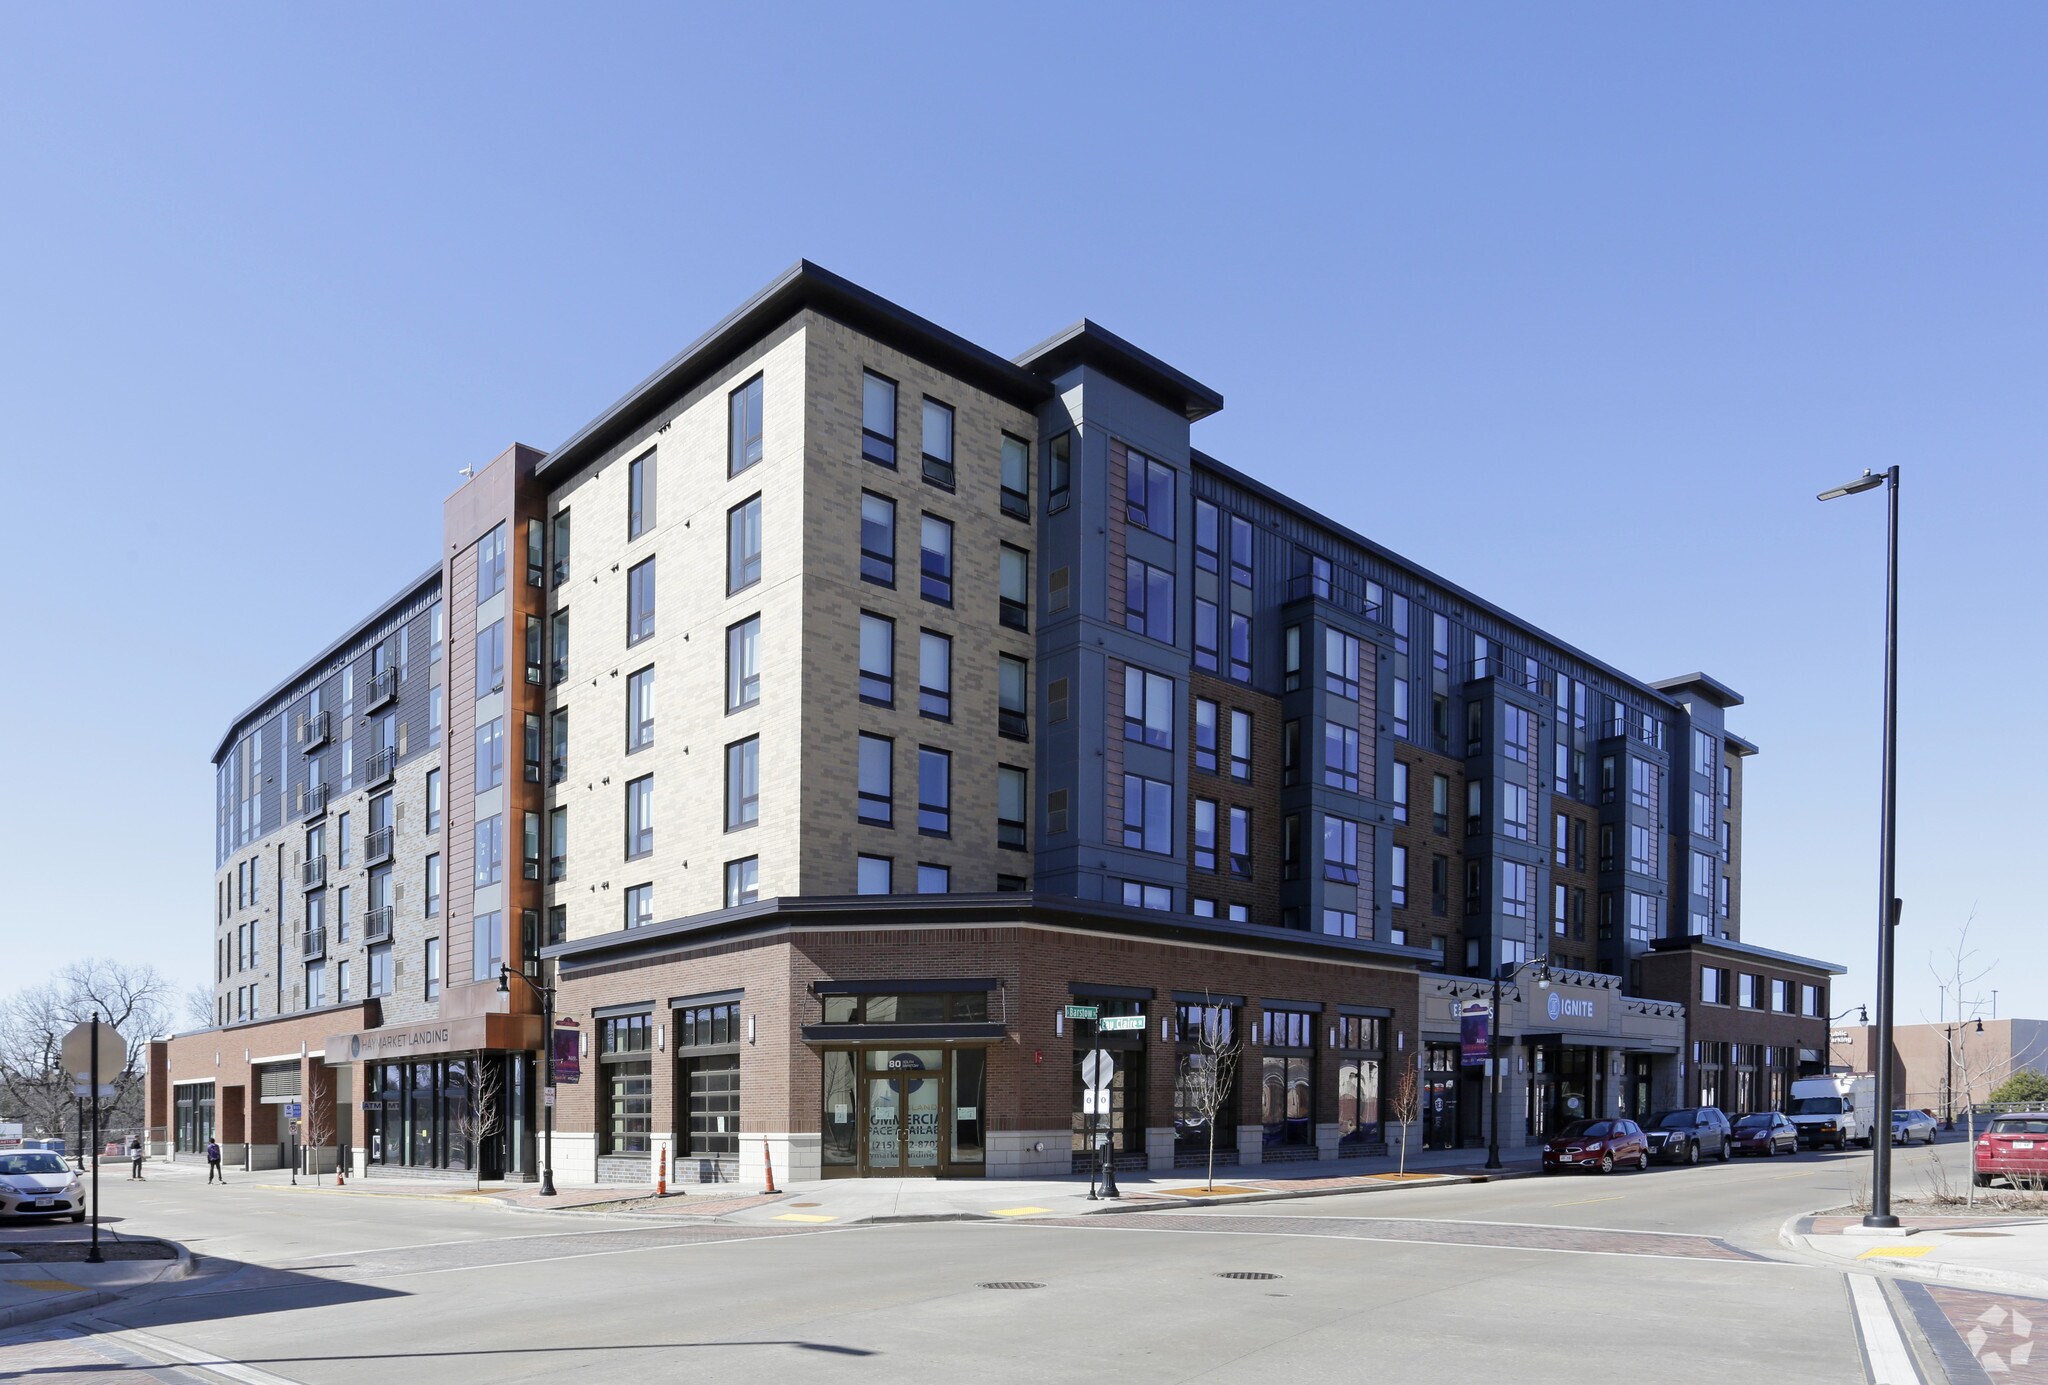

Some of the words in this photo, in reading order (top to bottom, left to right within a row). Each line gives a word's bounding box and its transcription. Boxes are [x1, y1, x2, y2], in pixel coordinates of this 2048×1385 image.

[1069, 1007, 1092, 1017] Barstow
[1561, 999, 1593, 1017] IGNITE
[1101, 1020, 1114, 1029] Eau
[1116, 1019, 1137, 1028] Claire
[361, 1034, 407, 1052] HAYMARKET
[408, 1028, 449, 1046] LANDING
[888, 1060, 901, 1068] 80
[870, 1113, 938, 1126] OMMERCIA
[869, 1126, 893, 1135] PACE
[872, 1141, 895, 1150] (715)
